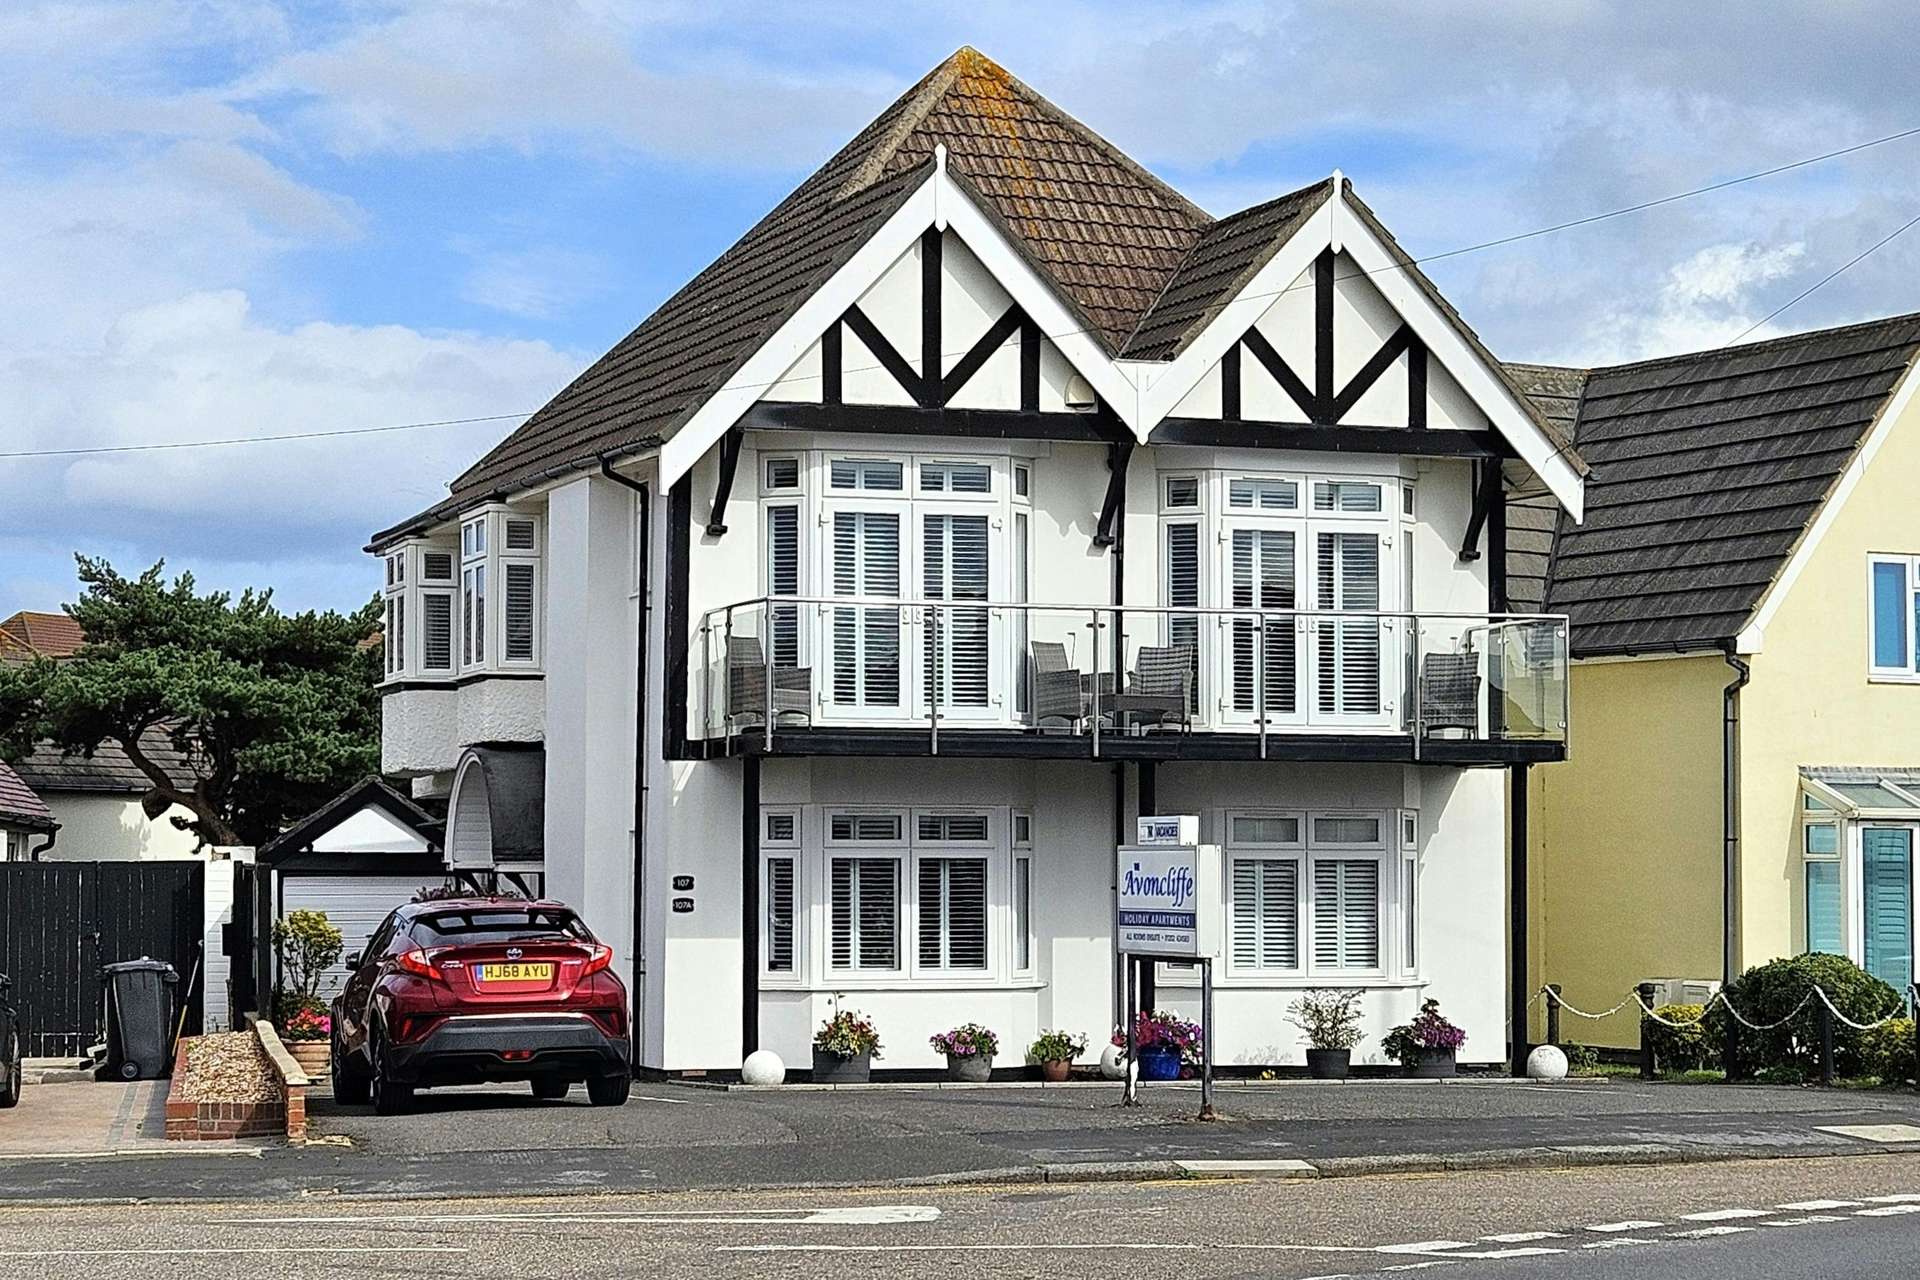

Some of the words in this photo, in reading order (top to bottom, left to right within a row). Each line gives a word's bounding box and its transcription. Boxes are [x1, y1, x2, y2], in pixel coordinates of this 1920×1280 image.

[677, 879, 690, 887] 107
[1122, 867, 1193, 907] Avoncliffe
[675, 901, 692, 909] 107A
[1124, 914, 1149, 924] HOLIDAY
[1151, 914, 1190, 926] APARTMENTS
[485, 966, 519, 978] HJ68
[523, 965, 549, 977] AYU
